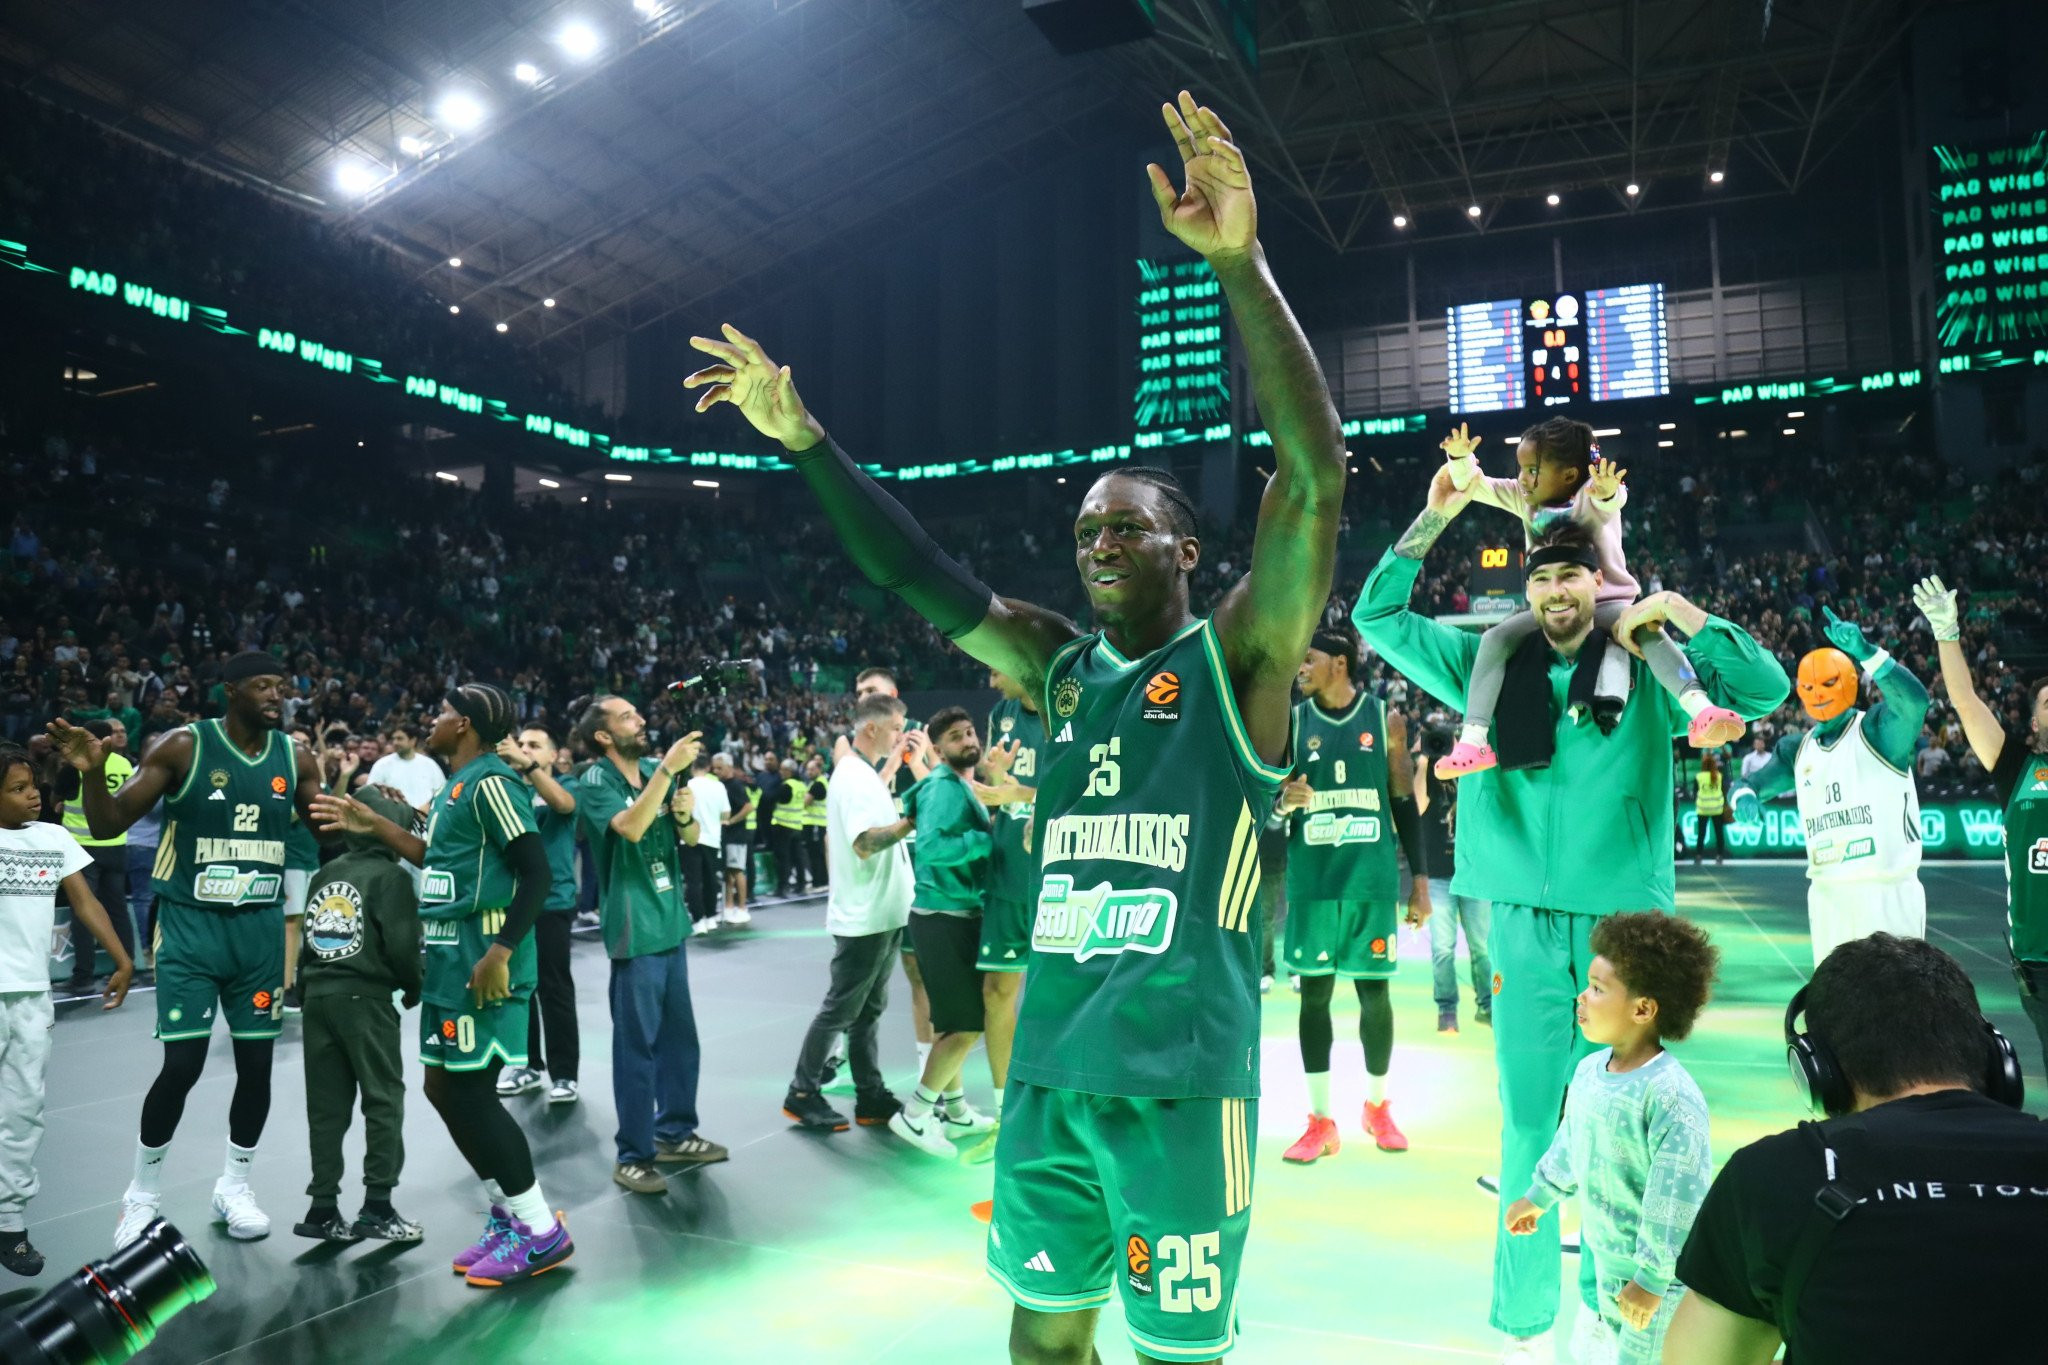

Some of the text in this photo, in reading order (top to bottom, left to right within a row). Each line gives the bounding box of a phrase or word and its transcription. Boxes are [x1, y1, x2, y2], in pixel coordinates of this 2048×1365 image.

[1941, 178, 1980, 201] PAO
[1943, 206, 1982, 227] PAO
[1944, 232, 1984, 255] PAO
[70, 267, 117, 296] PAO
[1946, 259, 1985, 281] PAO
[1947, 287, 1987, 307] PAO
[1481, 549, 1508, 568] 00
[1013, 747, 1036, 777] 20
[1082, 736, 1121, 796] 25
[1334, 760, 1346, 784] 8
[106, 773, 129, 789] SI
[234, 803, 261, 832] 22
[1387, 933, 1397, 962] 8
[457, 1015, 476, 1053] 0
[1157, 1230, 1222, 1313] 25
